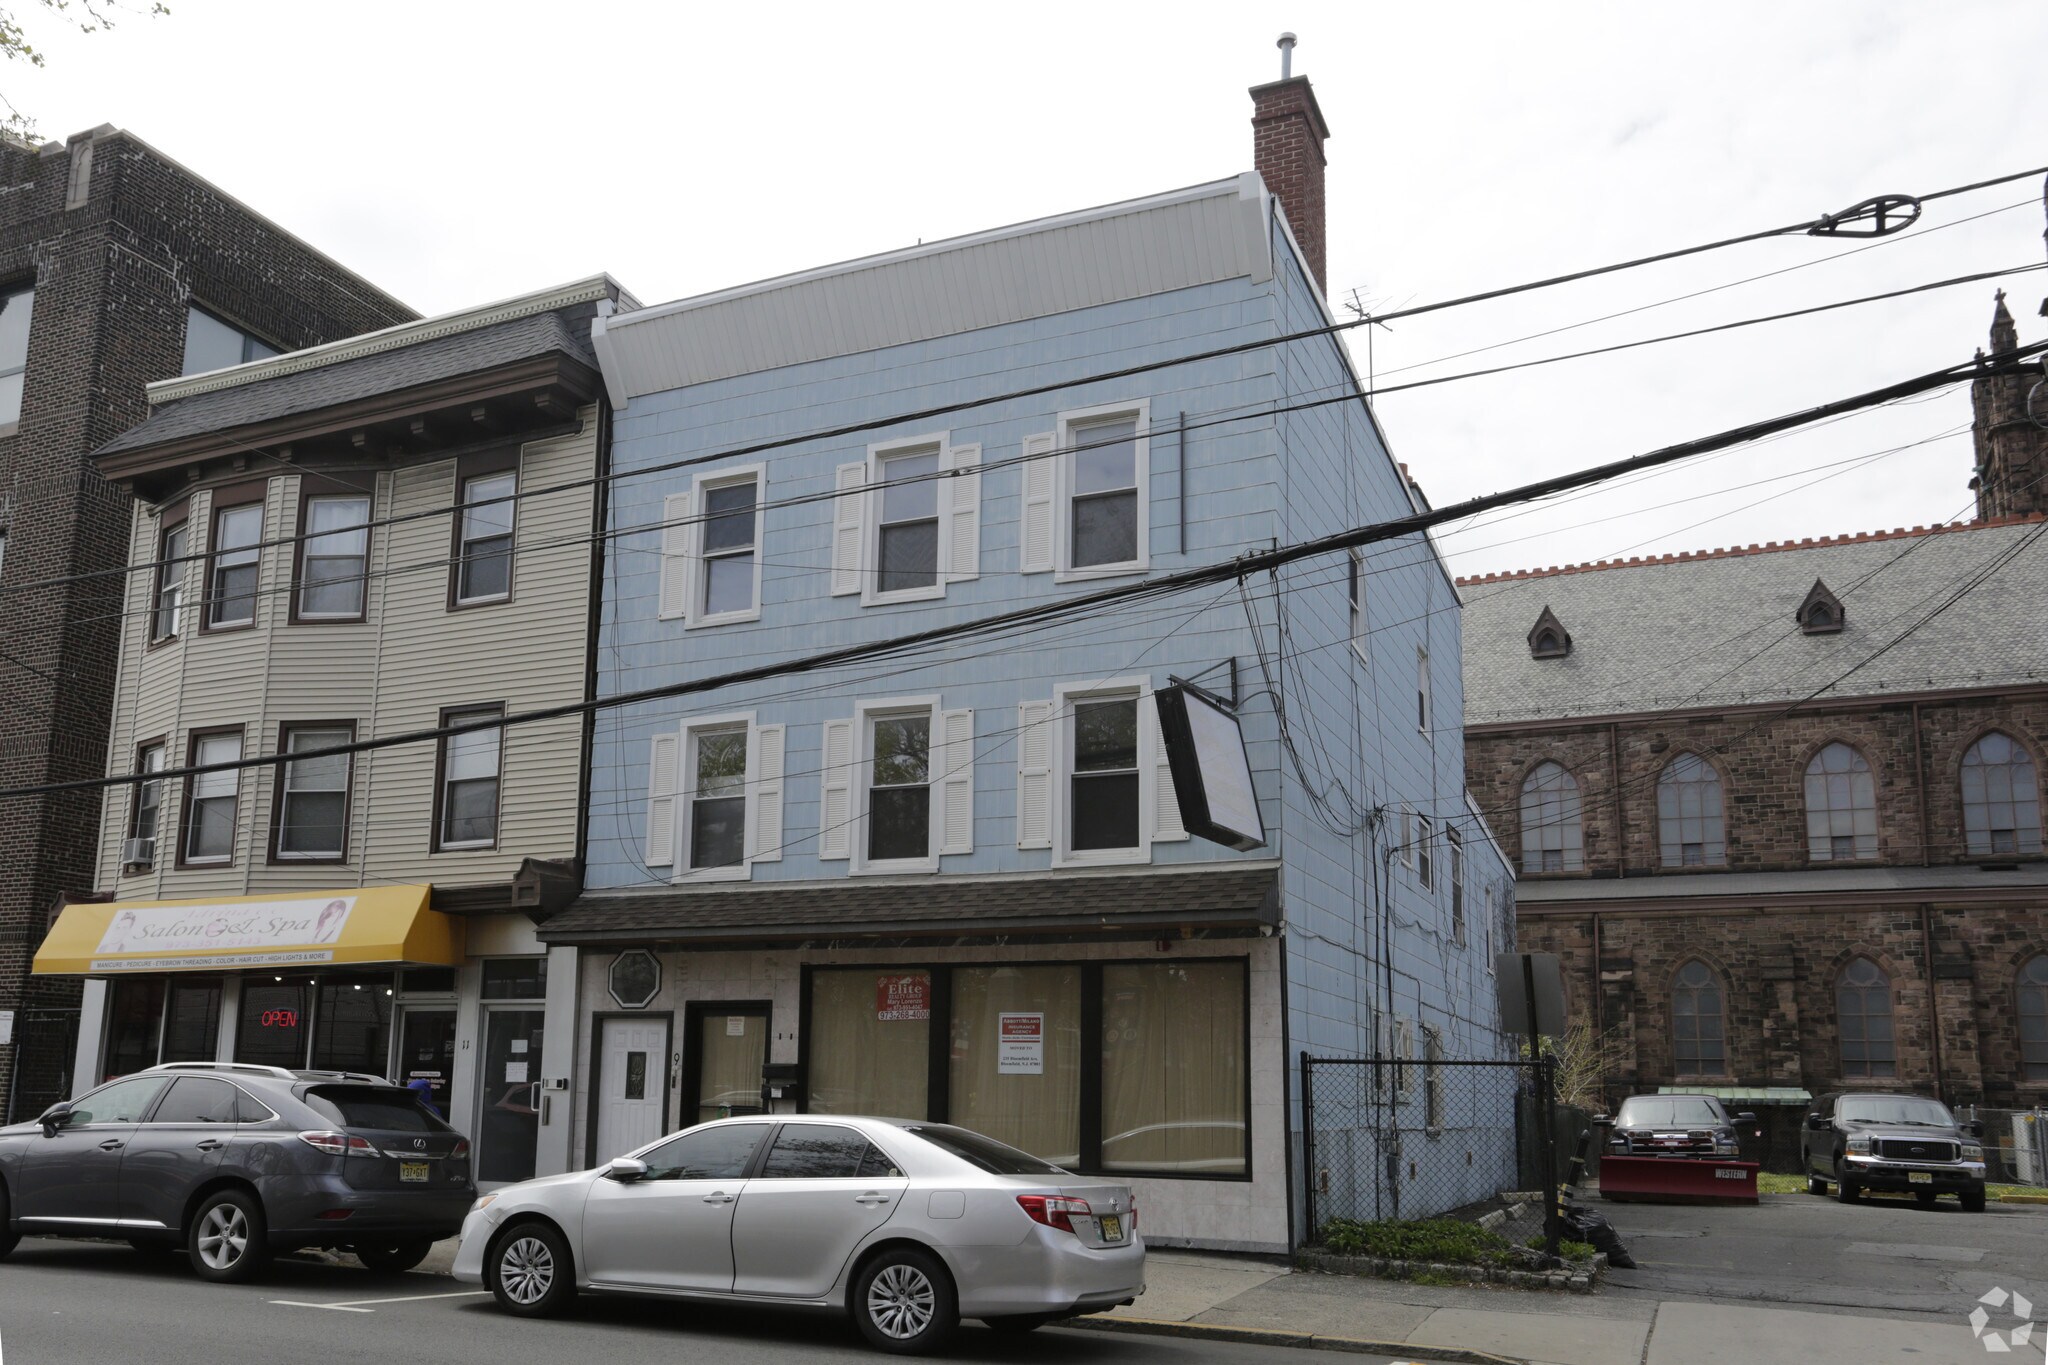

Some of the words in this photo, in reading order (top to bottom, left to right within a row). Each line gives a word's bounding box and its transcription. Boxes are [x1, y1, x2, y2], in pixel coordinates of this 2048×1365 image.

[133, 920, 205, 940] Salon
[228, 916, 262, 934] &
[259, 917, 312, 937] Spa
[97, 961, 123, 969] MANICURE
[127, 960, 152, 968] PEDICURE
[155, 959, 182, 967] EYEBROW
[182, 958, 212, 966] THREADING
[253, 955, 265, 963] CUT
[283, 953, 303, 961] LIGHTS
[309, 952, 326, 960] MORE
[888, 984, 923, 995] Elite
[262, 1011, 297, 1027] OPEN
[879, 1010, 930, 1020] 973-268-4000
[674, 1052, 680, 1066] 9
[1715, 1168, 1748, 1180] WESTERN
